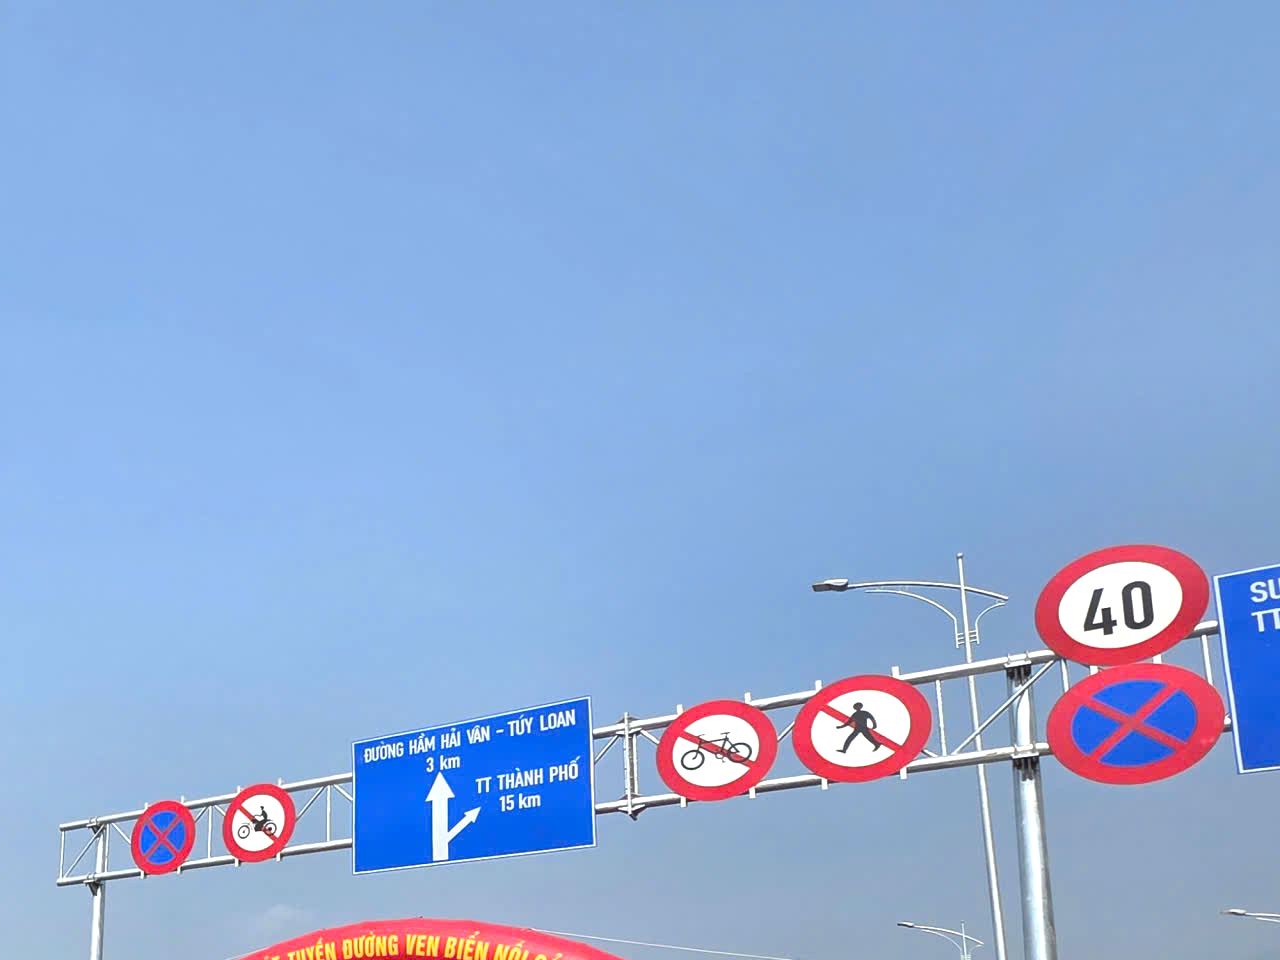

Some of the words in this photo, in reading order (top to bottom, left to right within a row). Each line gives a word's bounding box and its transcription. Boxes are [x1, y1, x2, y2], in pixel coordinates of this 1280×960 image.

[1250, 578, 1280, 603] SU
[1083, 581, 1155, 636] 40
[1251, 608, 1280, 632] TT
[363, 738, 404, 763] ĐƯỜNG
[409, 733, 436, 755] HẦM
[440, 728, 461, 750] HẢI
[467, 724, 490, 745] VÂN
[507, 714, 533, 737] TÚY
[540, 709, 576, 731] LOAN
[426, 756, 434, 773] 3
[439, 754, 461, 771] km
[475, 776, 492, 794] TT
[496, 767, 544, 791] THÀNH
[549, 756, 581, 783] PHỐ
[499, 794, 515, 812] 15
[518, 793, 541, 810] km
[342, 931, 399, 960] ĐƯỜNG
[406, 934, 441, 958] VEN
